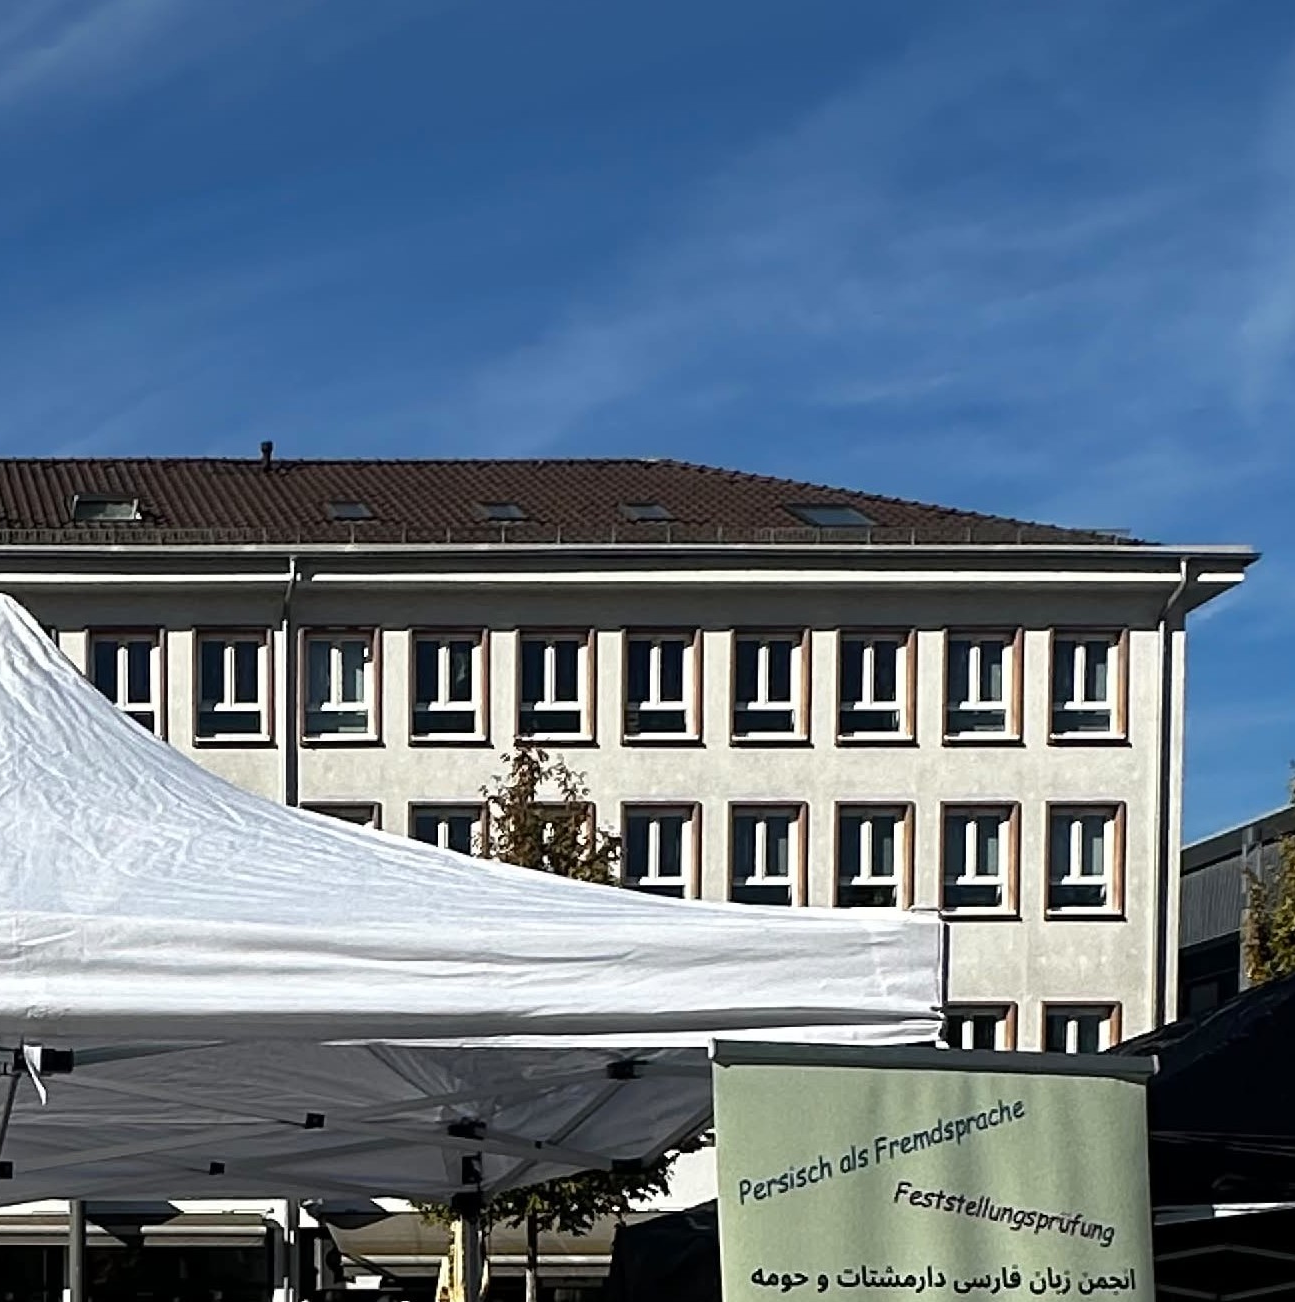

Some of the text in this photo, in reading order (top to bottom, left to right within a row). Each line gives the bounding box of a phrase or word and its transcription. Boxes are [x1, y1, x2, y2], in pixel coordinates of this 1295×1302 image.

[739, 1099, 1025, 1205] Persisch als Fremdsprache
[894, 1182, 1116, 1248] Feststellungsprüfung
[751, 1264, 1137, 1295] انجمن زبان فارسی دارمشتات و حومه
